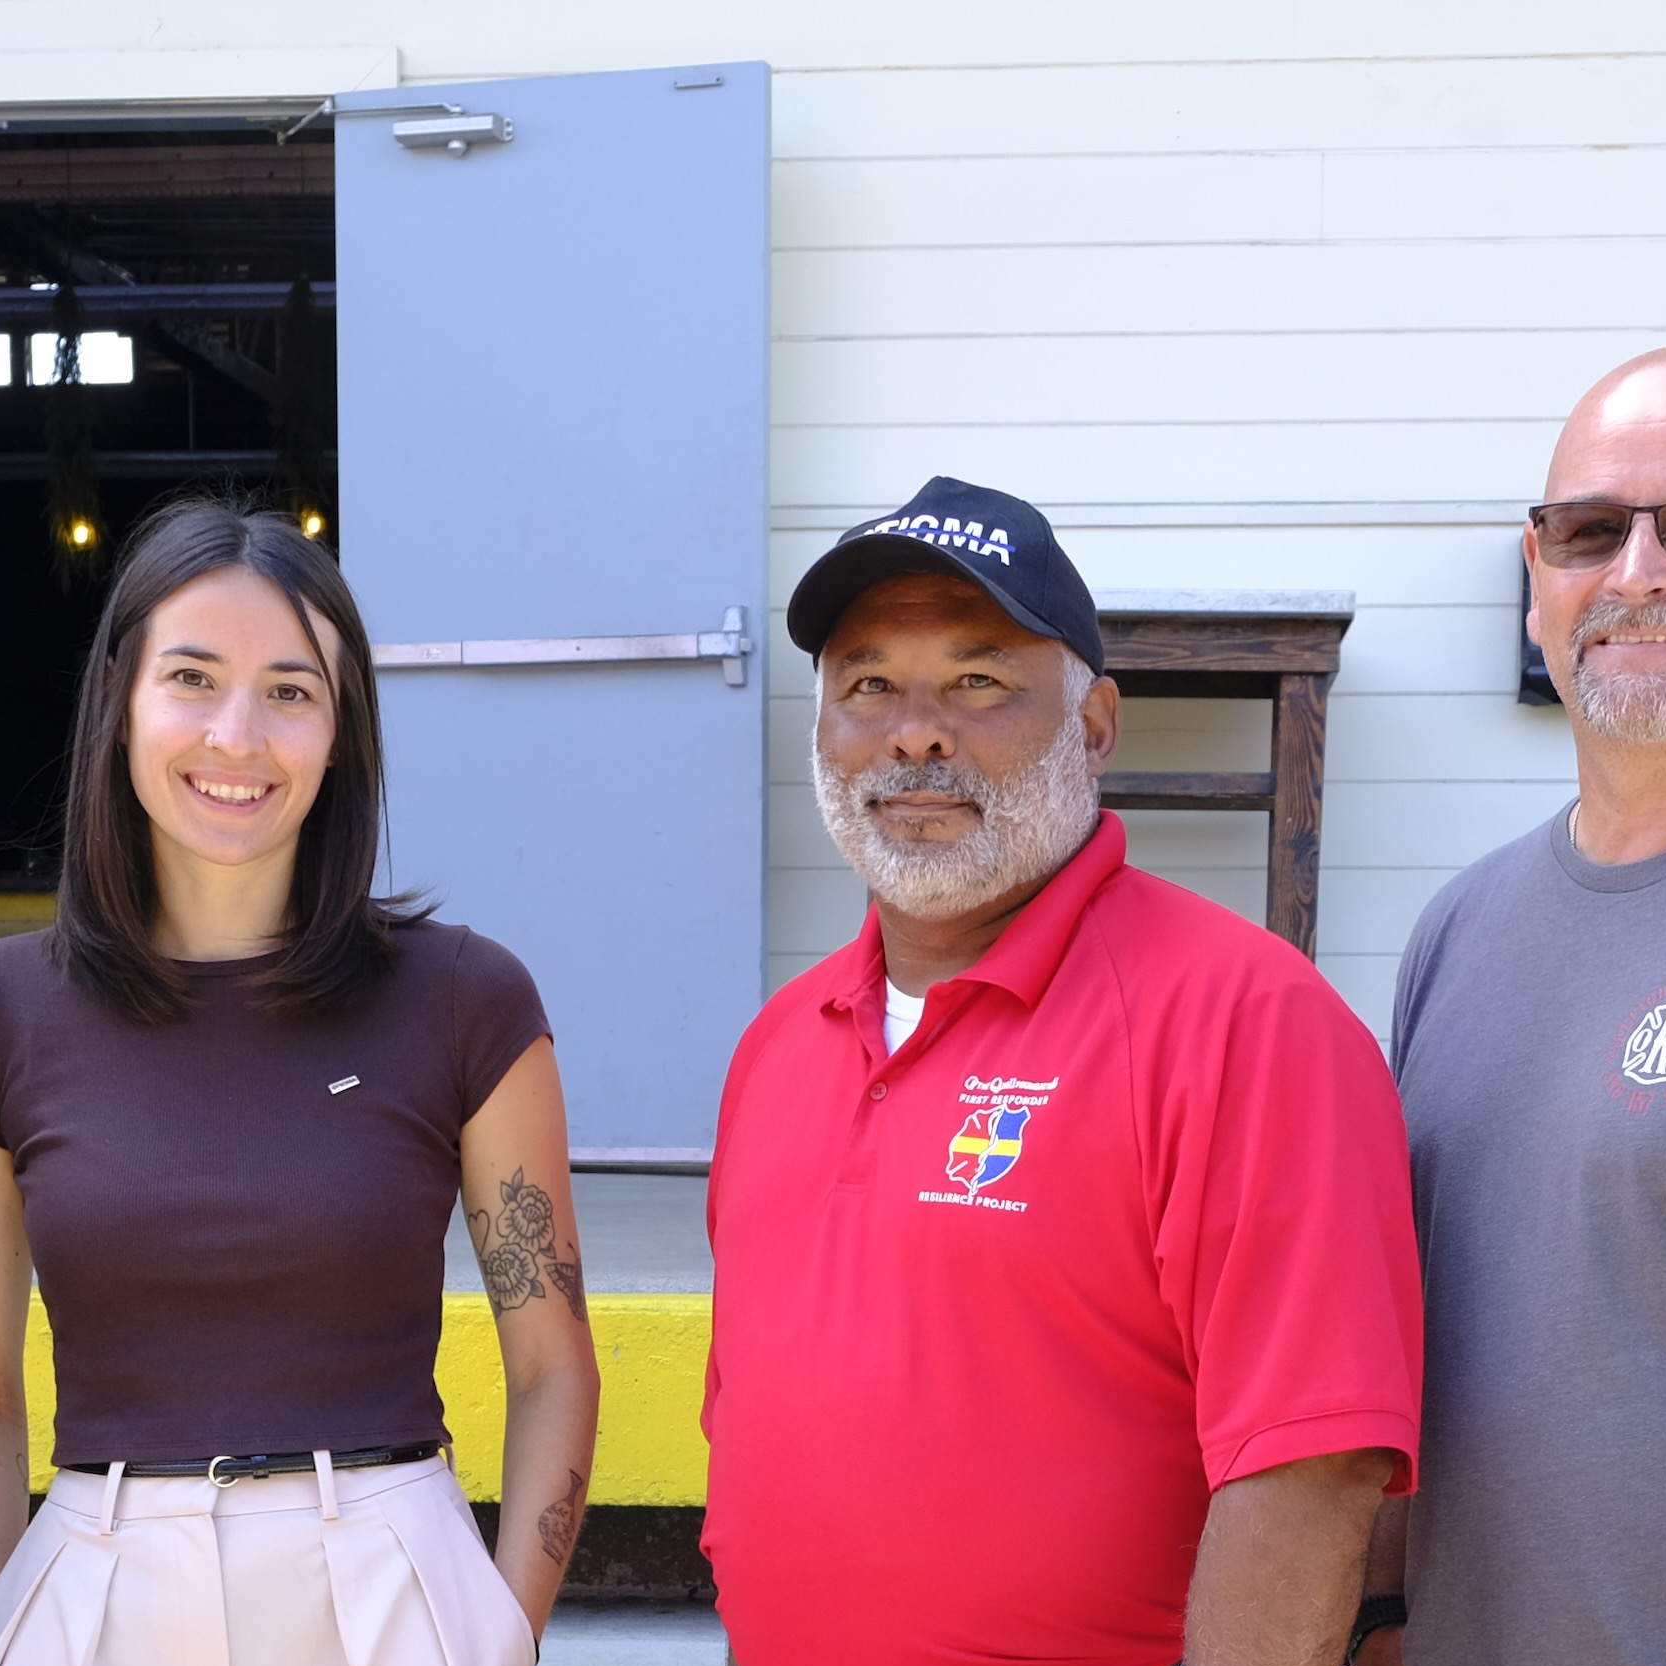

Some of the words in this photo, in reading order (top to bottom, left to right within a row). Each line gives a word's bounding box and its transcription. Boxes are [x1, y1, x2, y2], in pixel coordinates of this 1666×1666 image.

[863, 514, 1010, 566] TIGMA
[958, 1093, 989, 1104] FIRST
[990, 1095, 1049, 1106] RESPONDER
[918, 1191, 974, 1206] RESILIENCE
[975, 1196, 1028, 1212] PROJECT
